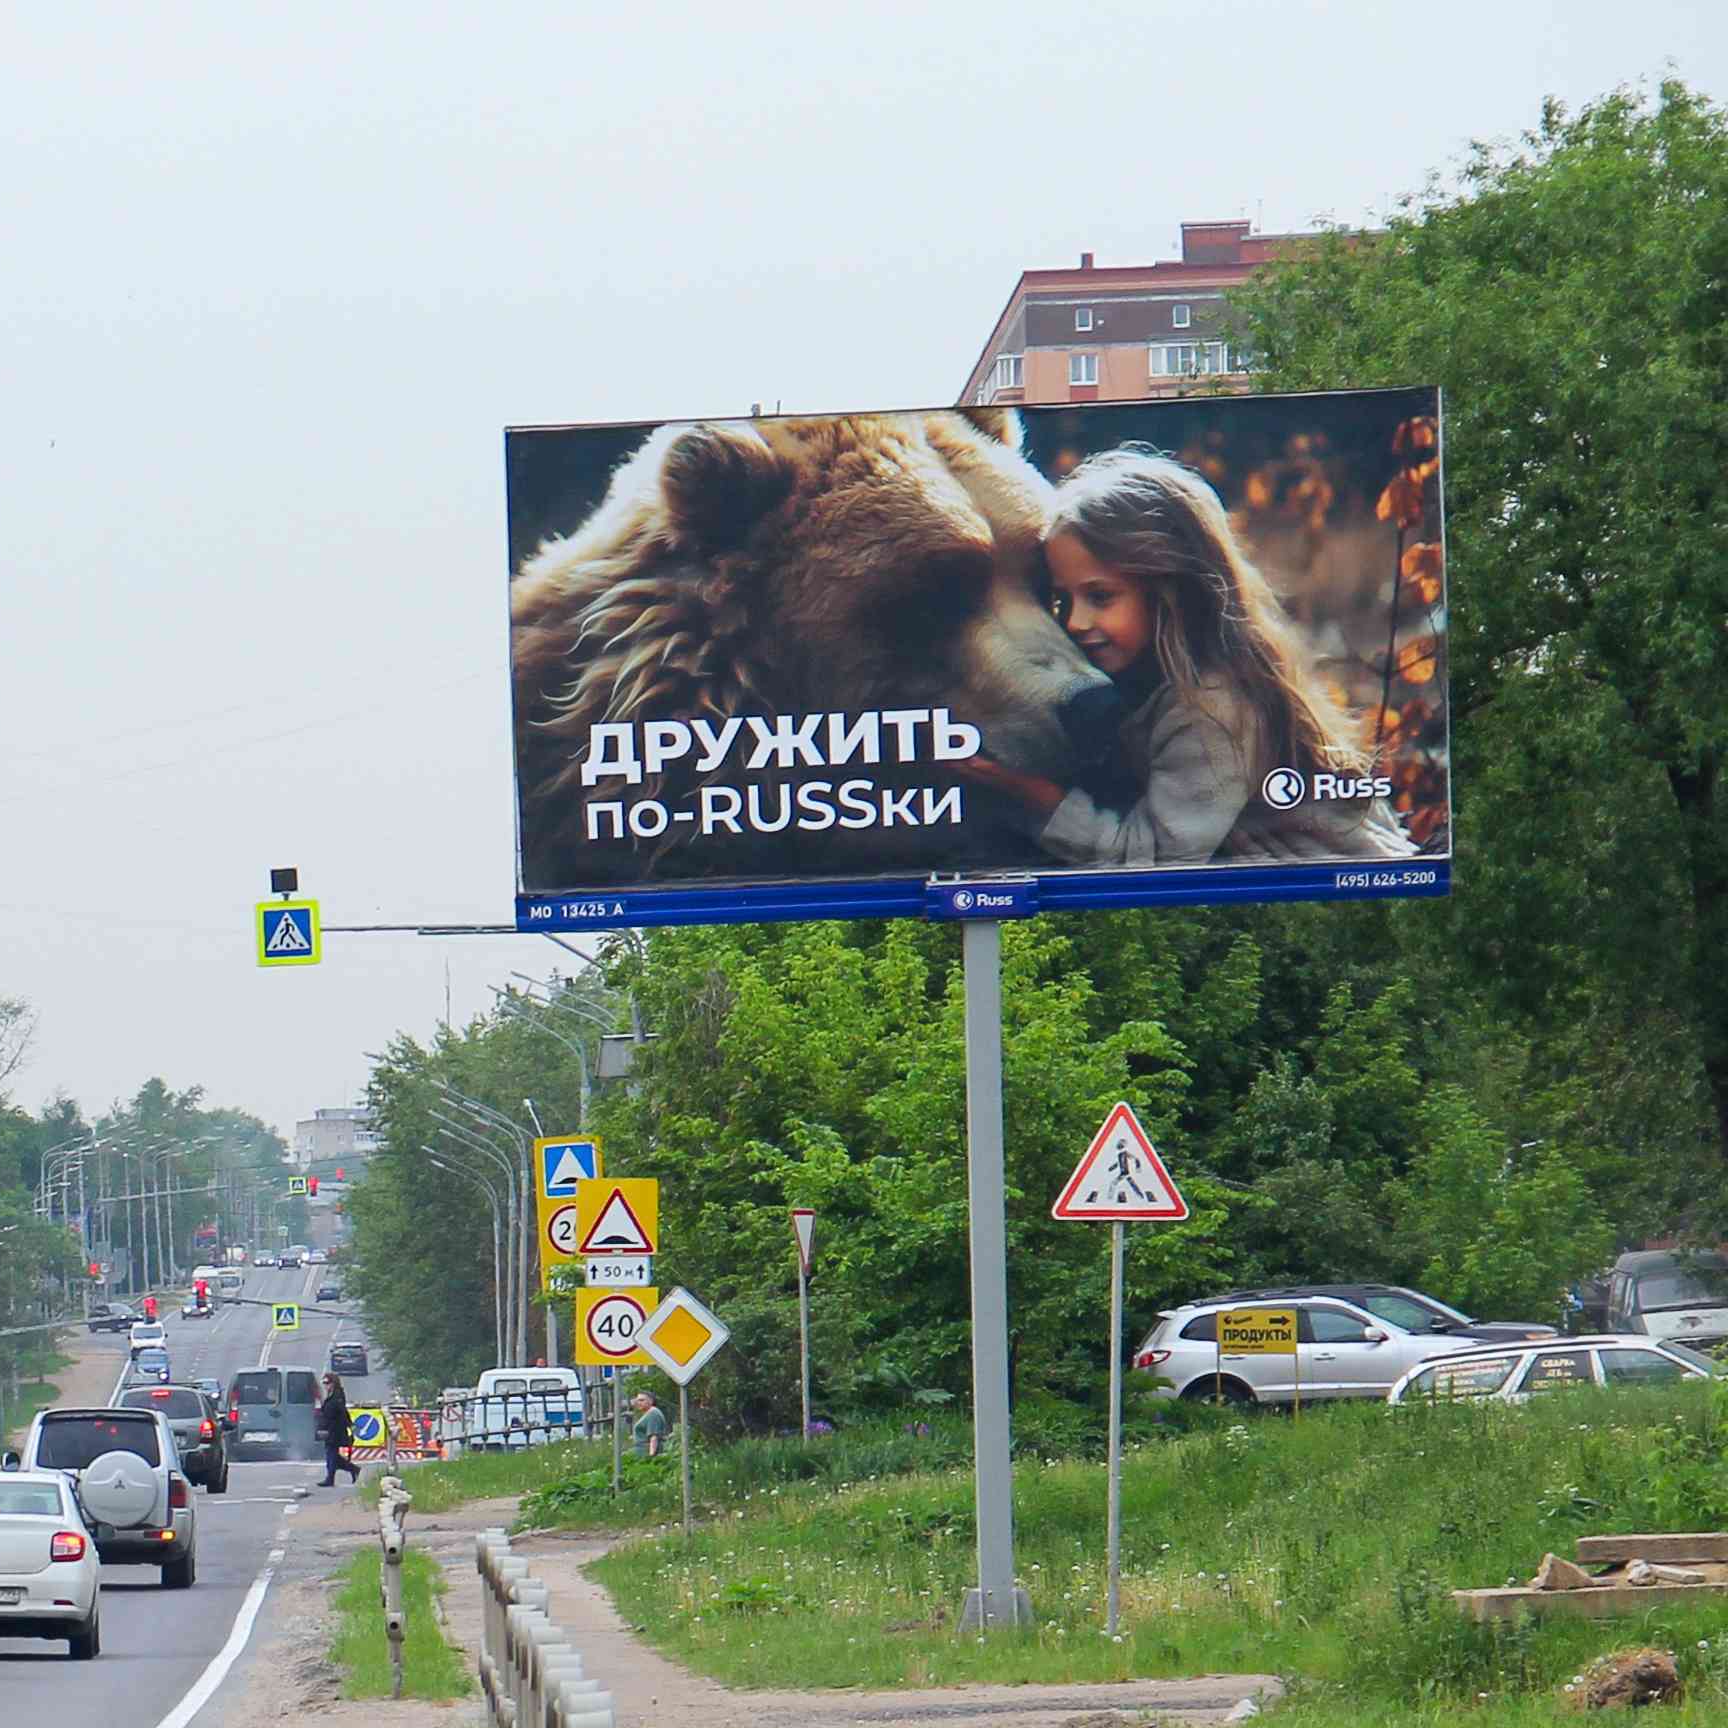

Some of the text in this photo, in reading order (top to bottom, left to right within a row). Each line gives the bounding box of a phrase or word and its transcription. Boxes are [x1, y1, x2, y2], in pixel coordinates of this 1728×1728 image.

[580, 708, 983, 786] ДРУЖИТЬ
[1312, 773, 1393, 800] Russ
[585, 779, 963, 841] по-RUSSки
[1335, 871, 1436, 889] (495) 626-5200
[976, 893, 1014, 907] Russ
[560, 903, 606, 918] 13425
[604, 1265, 622, 1278] 50
[597, 1314, 635, 1338] 40
[1223, 1328, 1292, 1344] ПРОДУКТЫ
